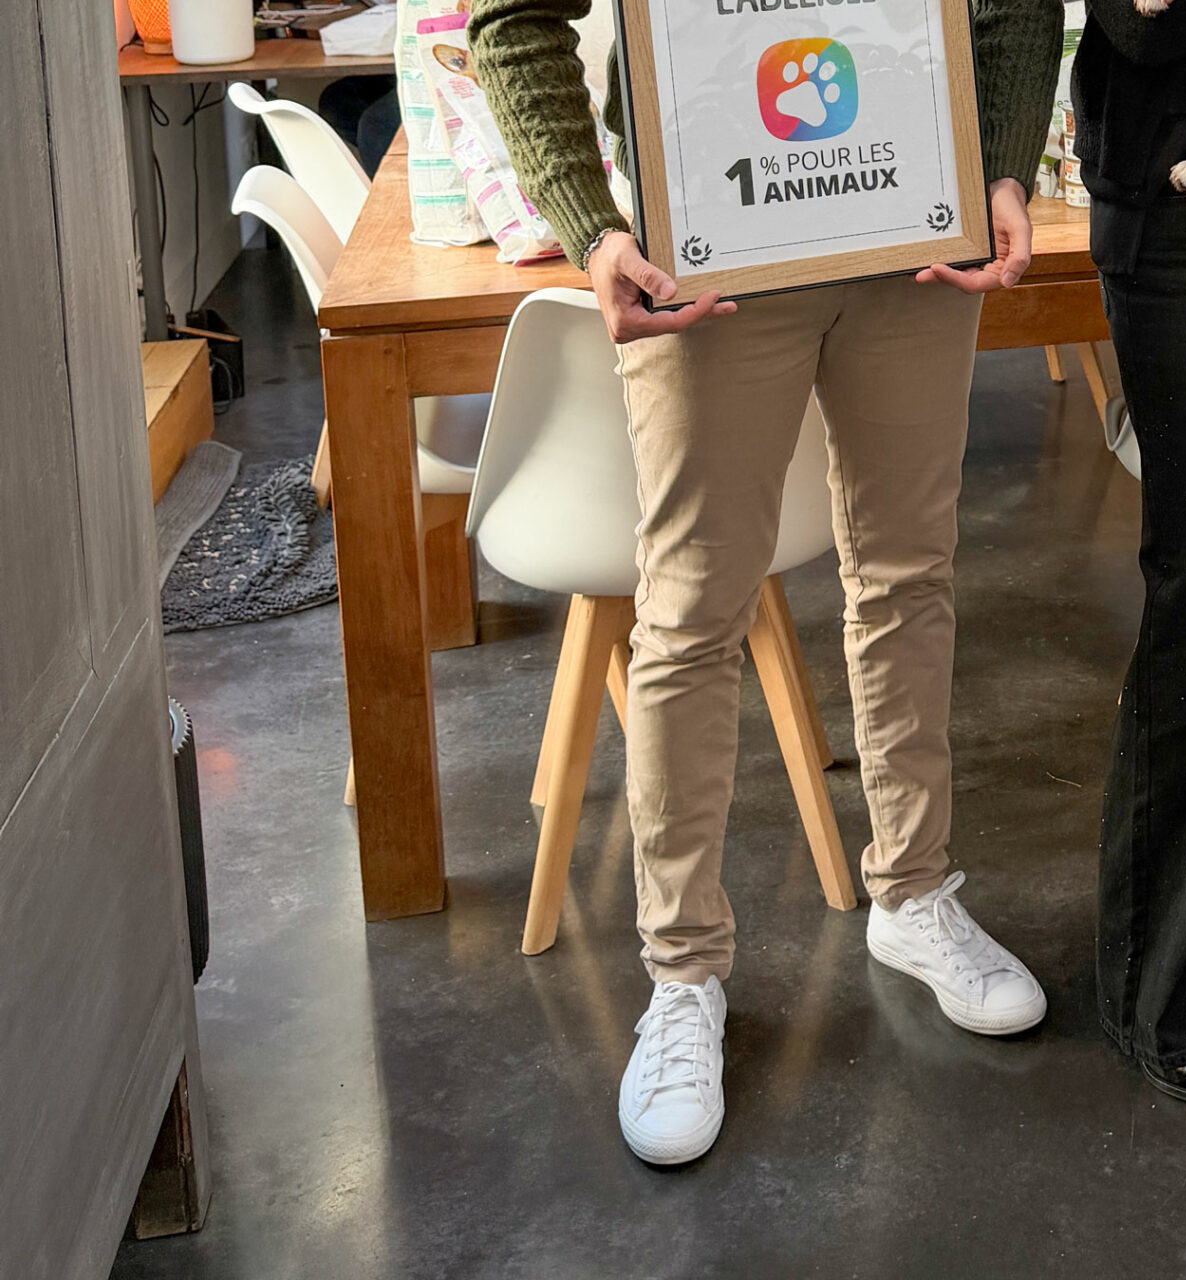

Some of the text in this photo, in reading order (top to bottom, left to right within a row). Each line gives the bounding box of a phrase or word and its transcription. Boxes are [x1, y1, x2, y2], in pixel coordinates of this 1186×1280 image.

[724, 141, 896, 207] 1 % POUR LES
[763, 167, 900, 205] ANIMAUX
